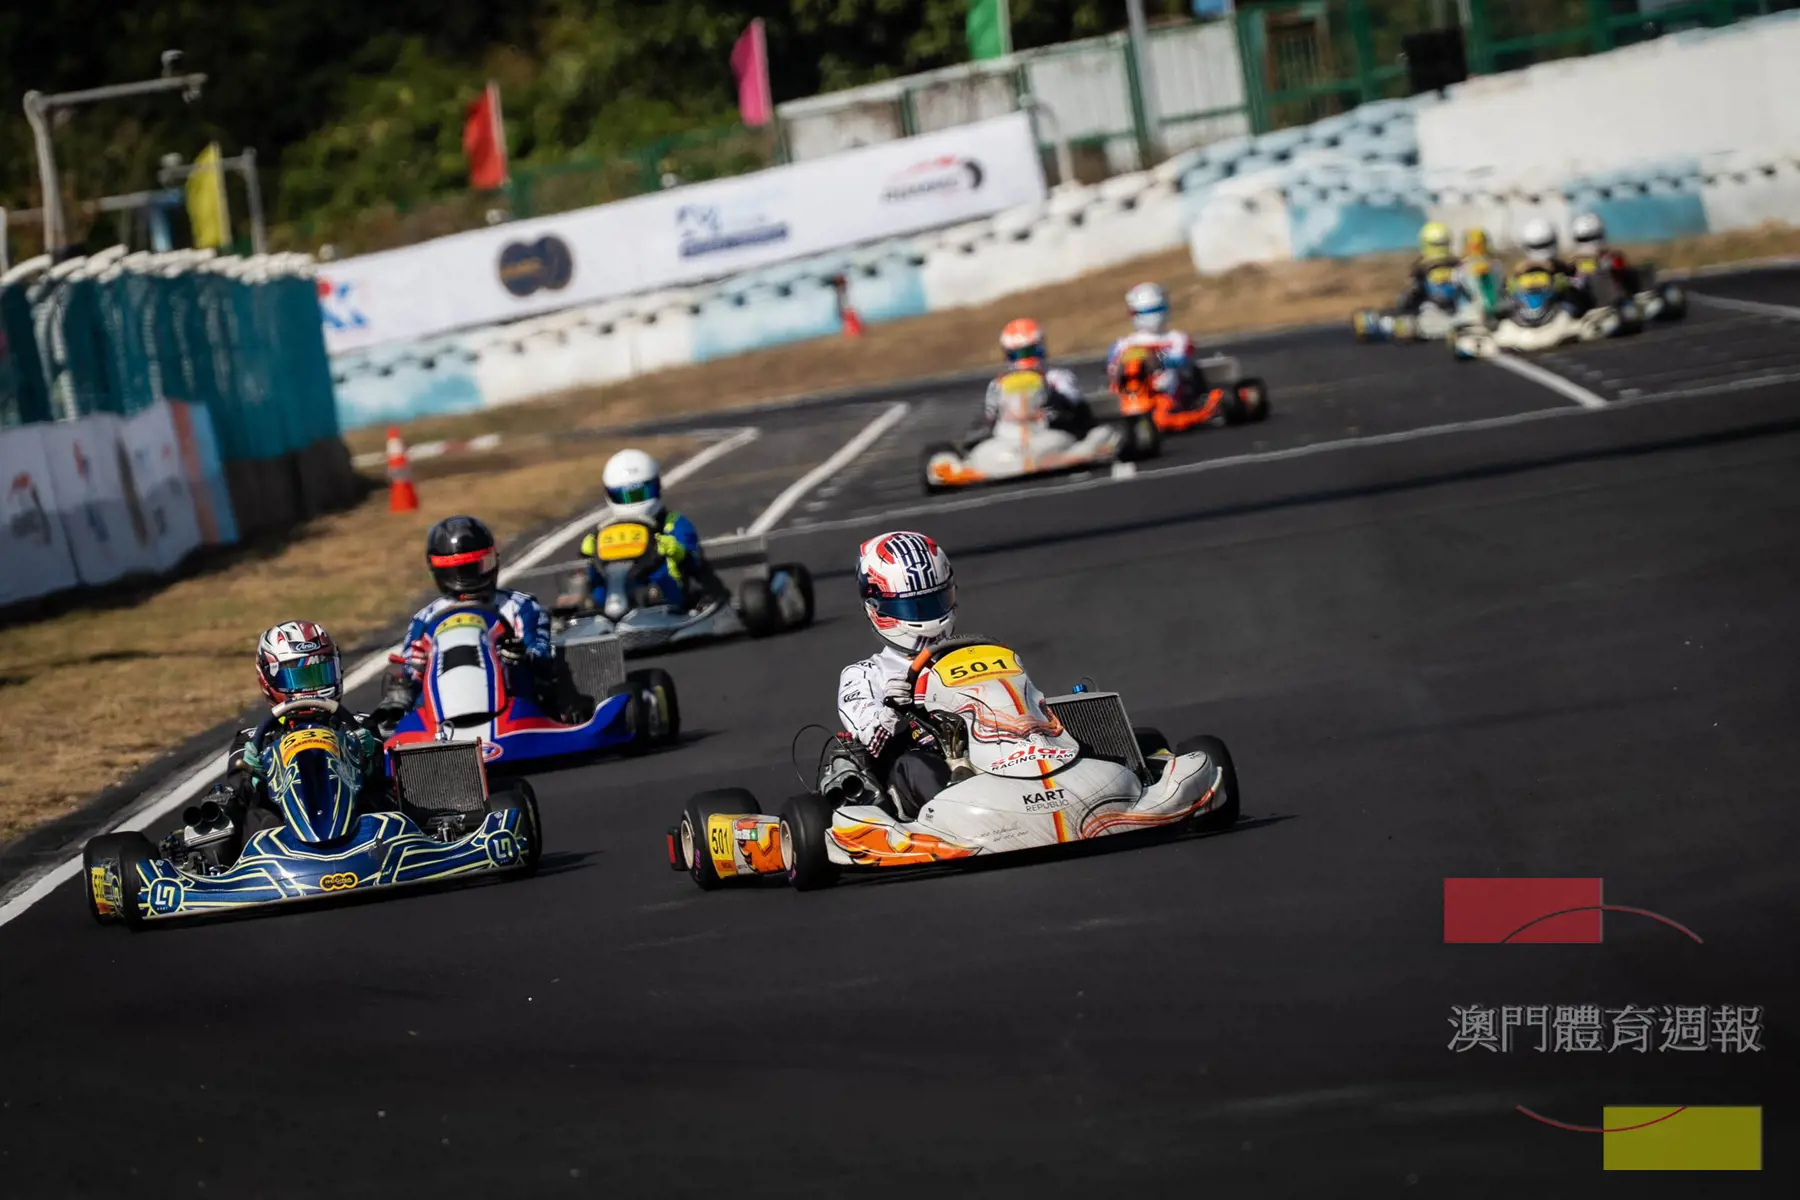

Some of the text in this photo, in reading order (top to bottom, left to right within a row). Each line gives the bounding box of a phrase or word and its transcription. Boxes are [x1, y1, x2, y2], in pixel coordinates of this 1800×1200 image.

[949, 658, 1009, 680] 501
[991, 752, 1074, 771] RACING TEAM
[1022, 788, 1065, 805] KART
[711, 827, 730, 855] 501
